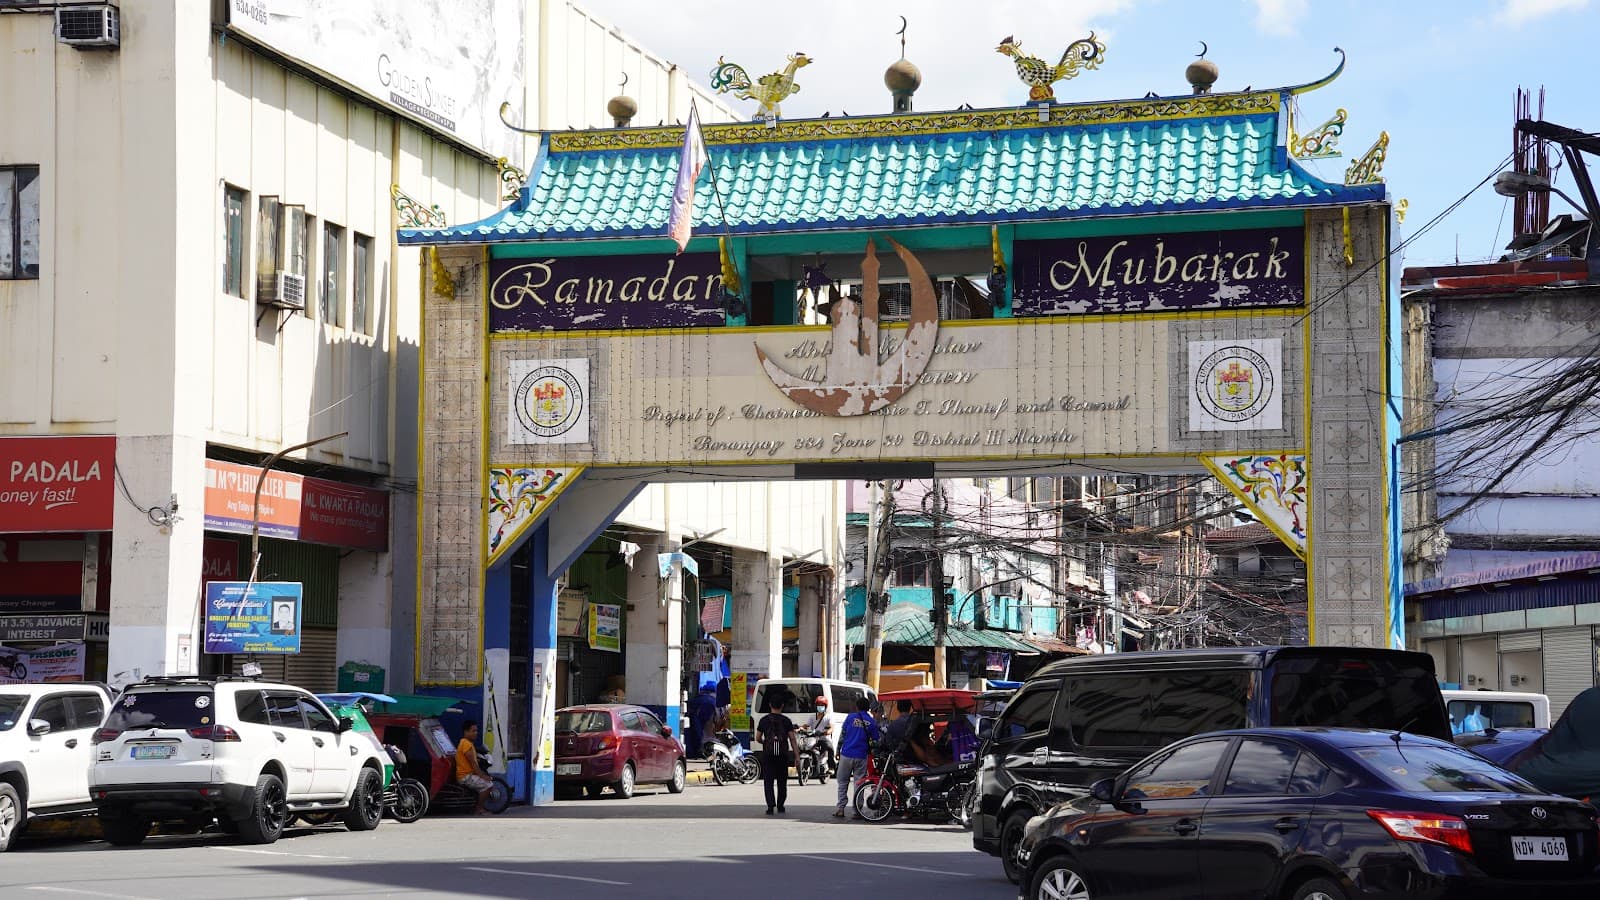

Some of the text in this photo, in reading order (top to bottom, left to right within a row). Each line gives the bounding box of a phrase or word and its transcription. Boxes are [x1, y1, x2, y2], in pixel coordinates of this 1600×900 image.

[378, 53, 456, 117] GOLDEN SUNSET
[1049, 237, 1290, 291] Mubarak
[643, 404, 703, 428] Project
[707, 405, 725, 427] of
[1016, 396, 1053, 413] and
[1059, 394, 1132, 412] Council
[693, 435, 785, 457] Barangay
[831, 432, 876, 454] Zone
[911, 430, 981, 447] District
[982, 428, 1005, 447] III
[1007, 426, 1079, 446] Manila
[10, 459, 101, 483] PADALA
[42, 487, 76, 501] fast!
[320, 494, 354, 512] KWARTA
[10, 618, 34, 628] 3.5%
[36, 617, 83, 627] ADVANCE
[7, 629, 57, 639] INTEREST
[1515, 840, 1566, 856] NDW 4069
